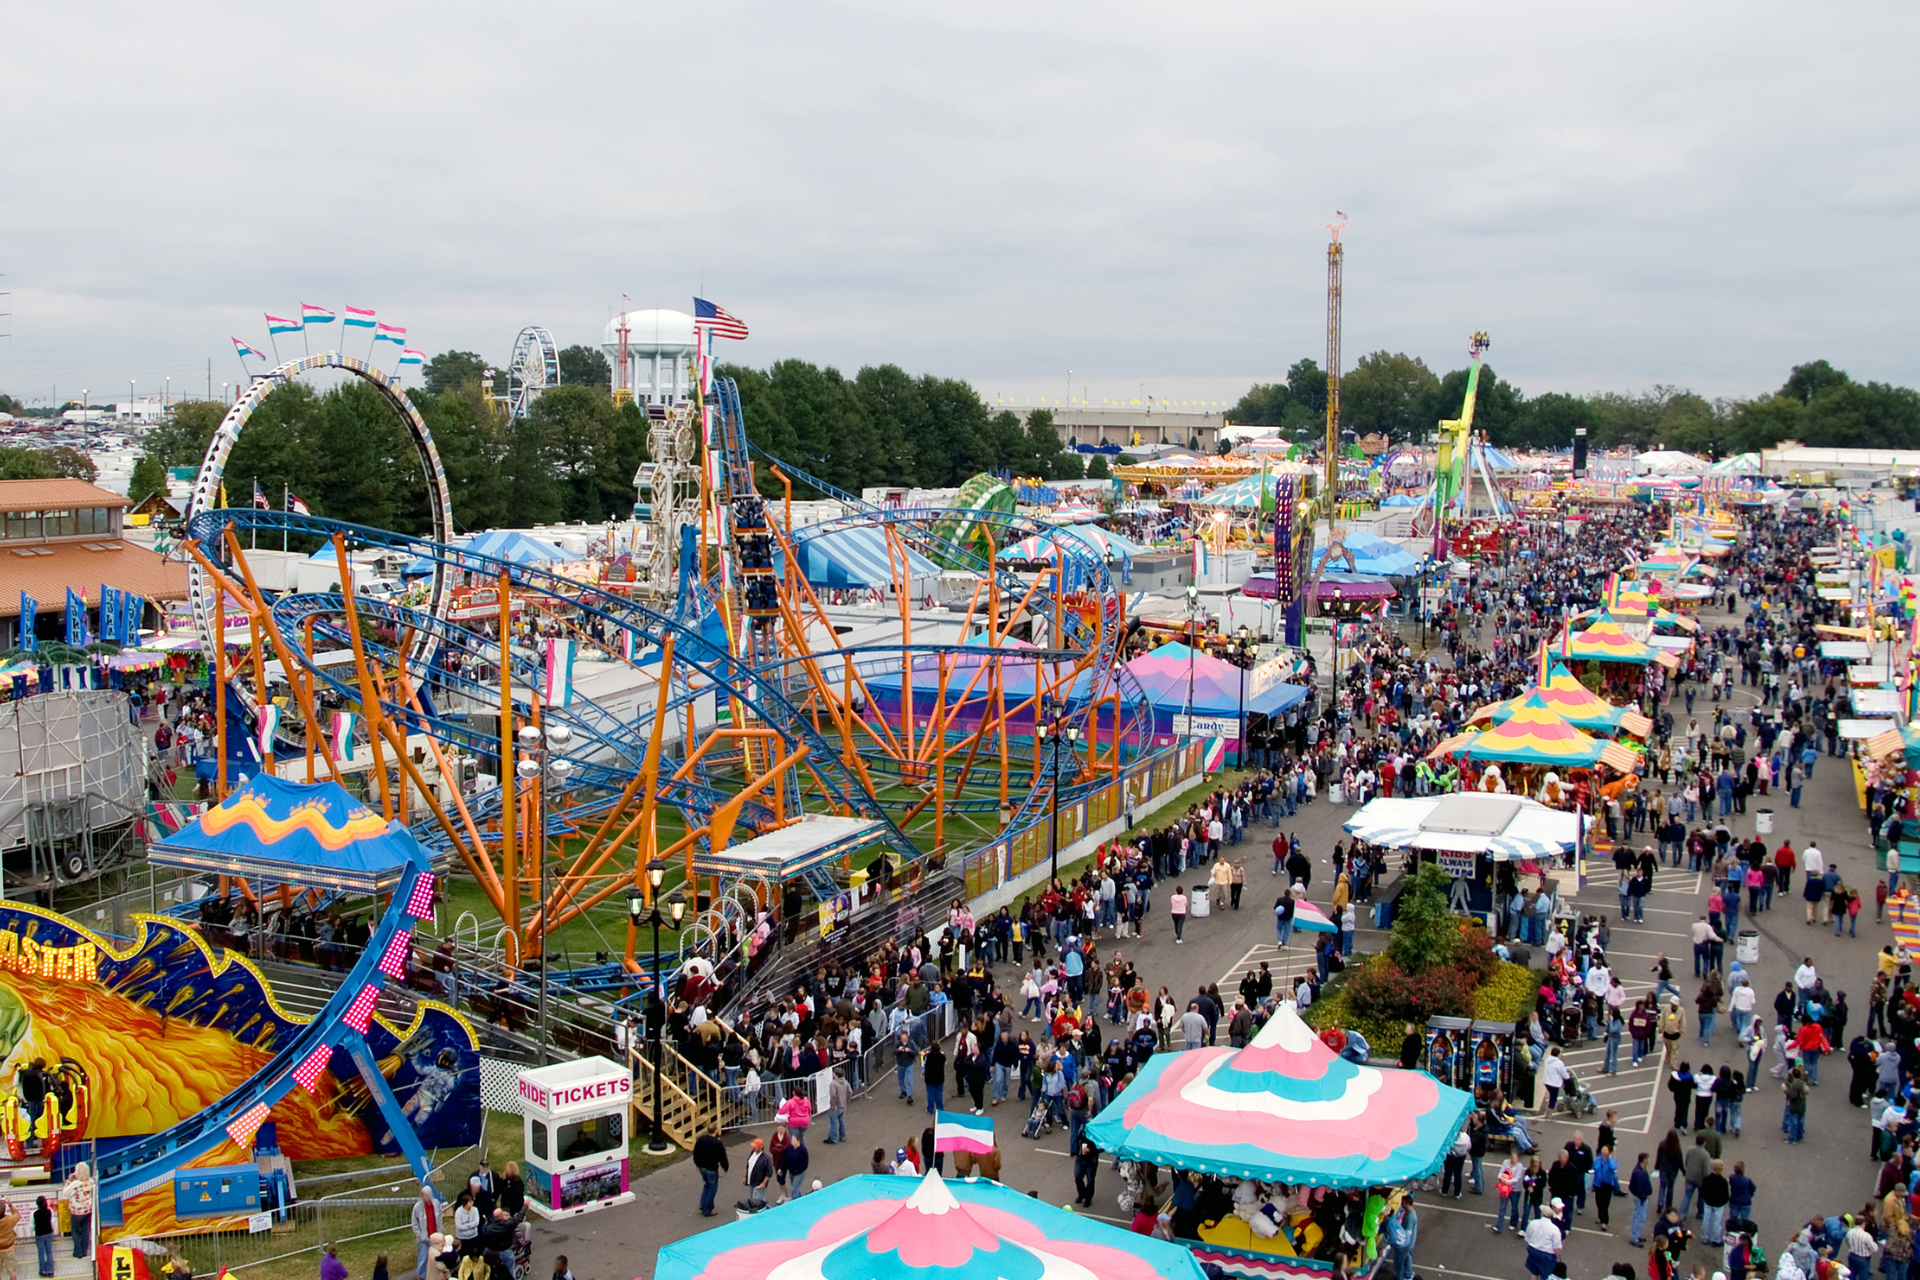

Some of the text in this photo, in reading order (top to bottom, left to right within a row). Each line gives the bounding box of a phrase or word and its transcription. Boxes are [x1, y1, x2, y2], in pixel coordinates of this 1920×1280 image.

[1438, 858, 1473, 868] ALWAYS
[519, 1078, 630, 1108] RIDE TICKETS
